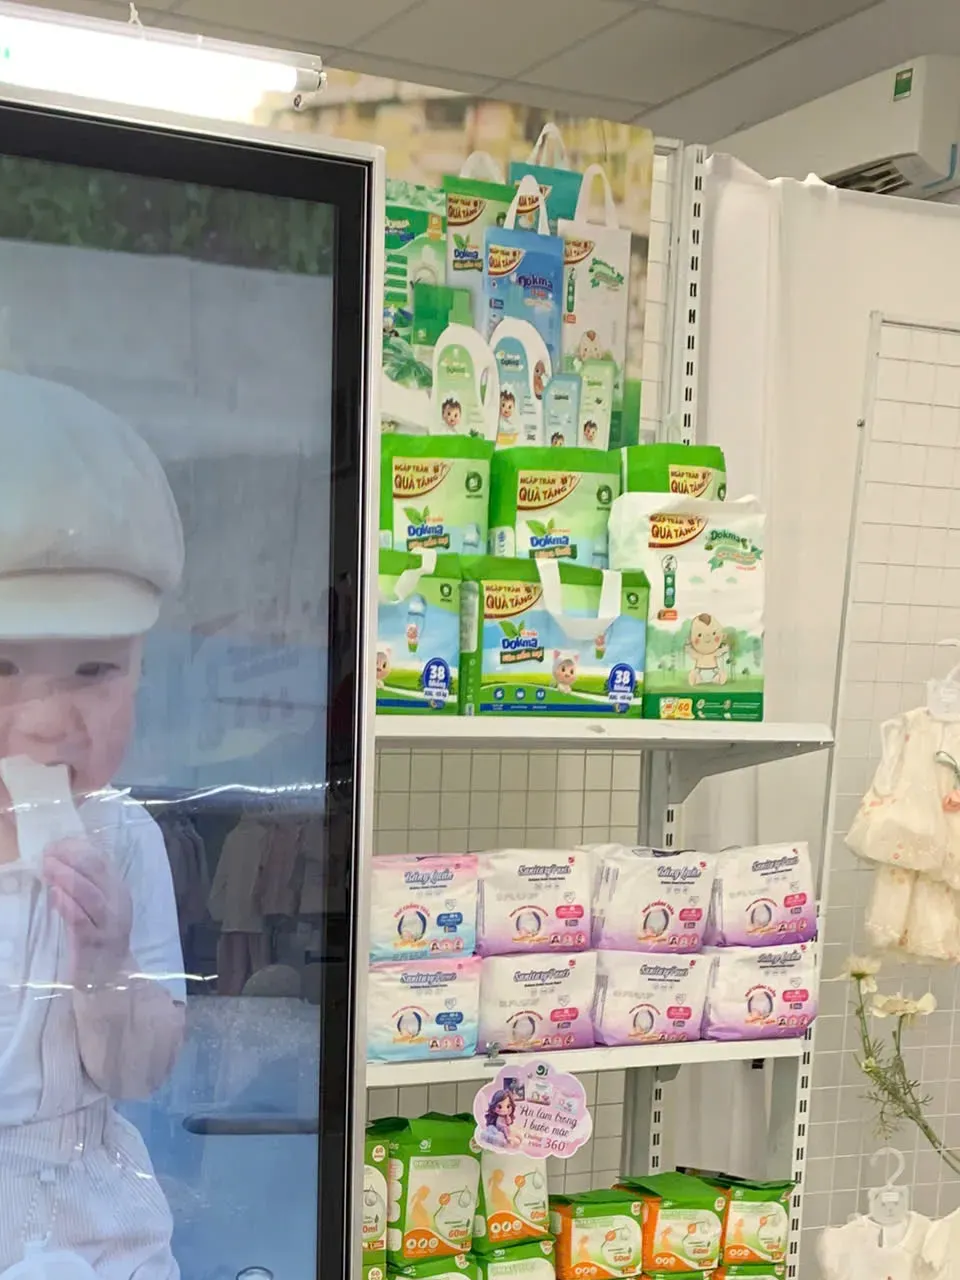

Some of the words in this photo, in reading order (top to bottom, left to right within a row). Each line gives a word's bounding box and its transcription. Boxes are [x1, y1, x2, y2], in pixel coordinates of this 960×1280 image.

[519, 486, 541, 502] QUÀ
[407, 523, 444, 537] Dokma
[651, 523, 673, 540] QUÀ
[530, 535, 569, 547] Dokma
[502, 637, 539, 650] Dokma
[429, 665, 446, 680] 38
[614, 671, 631, 685] 38
